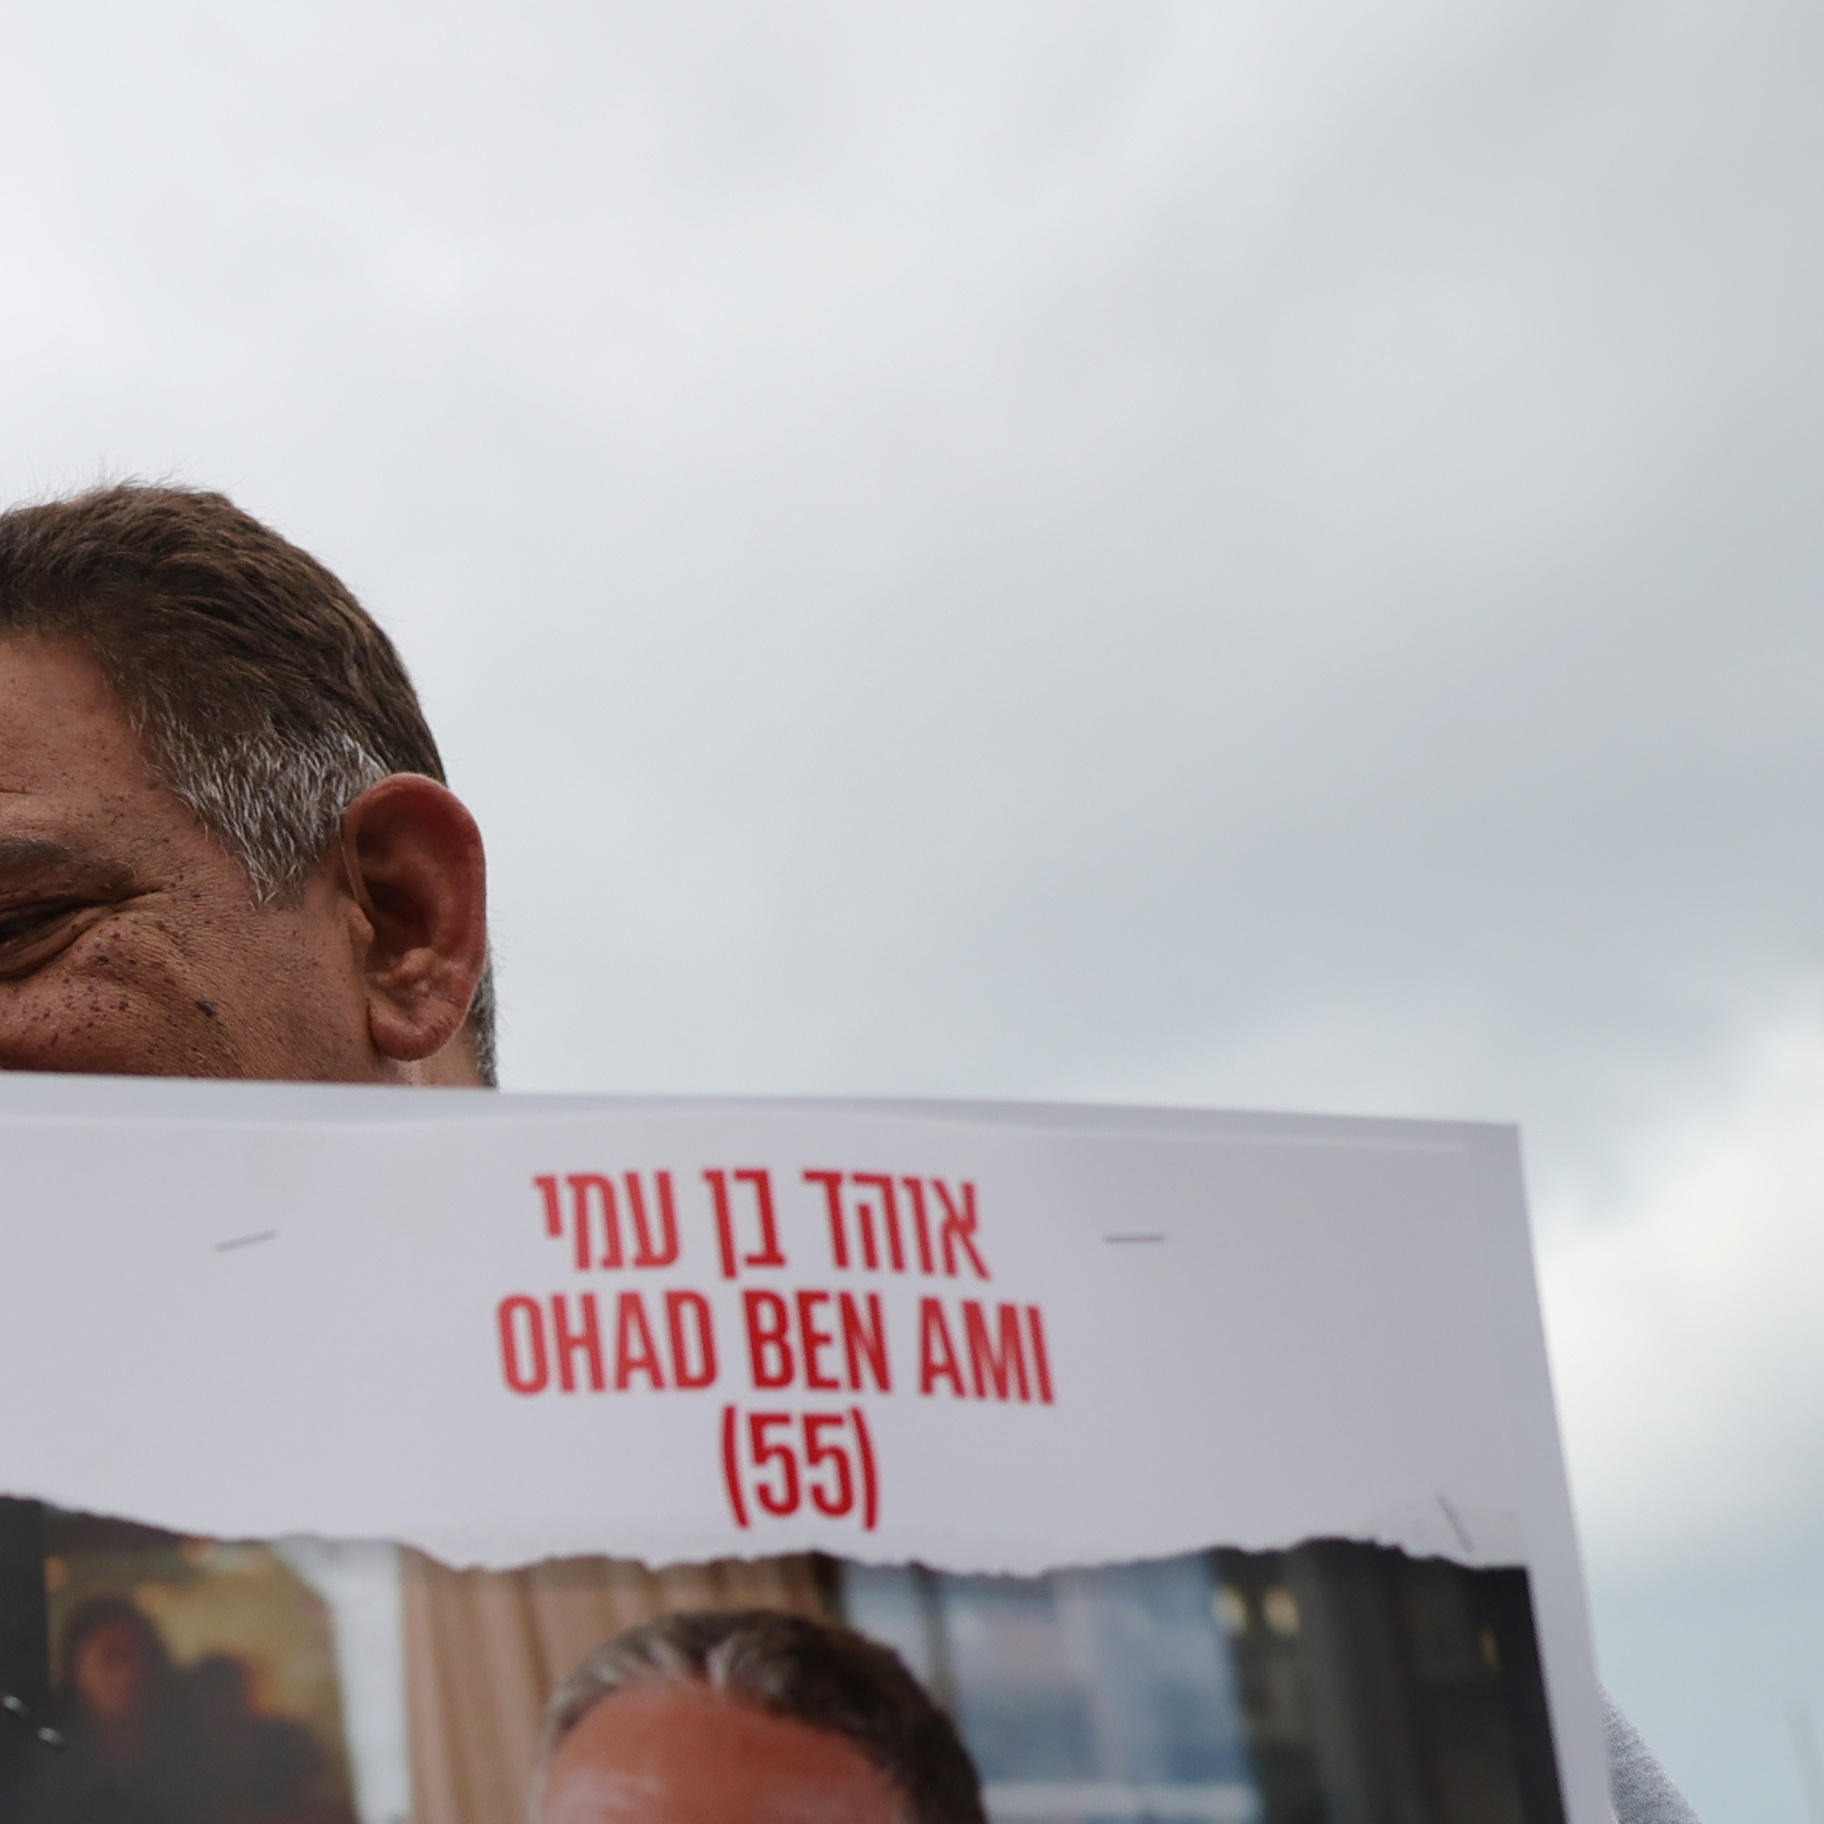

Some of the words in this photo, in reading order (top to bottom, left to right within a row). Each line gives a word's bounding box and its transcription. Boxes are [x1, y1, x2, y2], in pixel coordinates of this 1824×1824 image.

[532, 1170, 682, 1272] עמי
[701, 1168, 788, 1280] בן
[801, 1169, 992, 1281] אוהד
[495, 1289, 719, 1396] OHAD
[741, 1288, 892, 1394] BEN
[918, 1296, 1055, 1405] AMI
[719, 1404, 879, 1532] (55)
